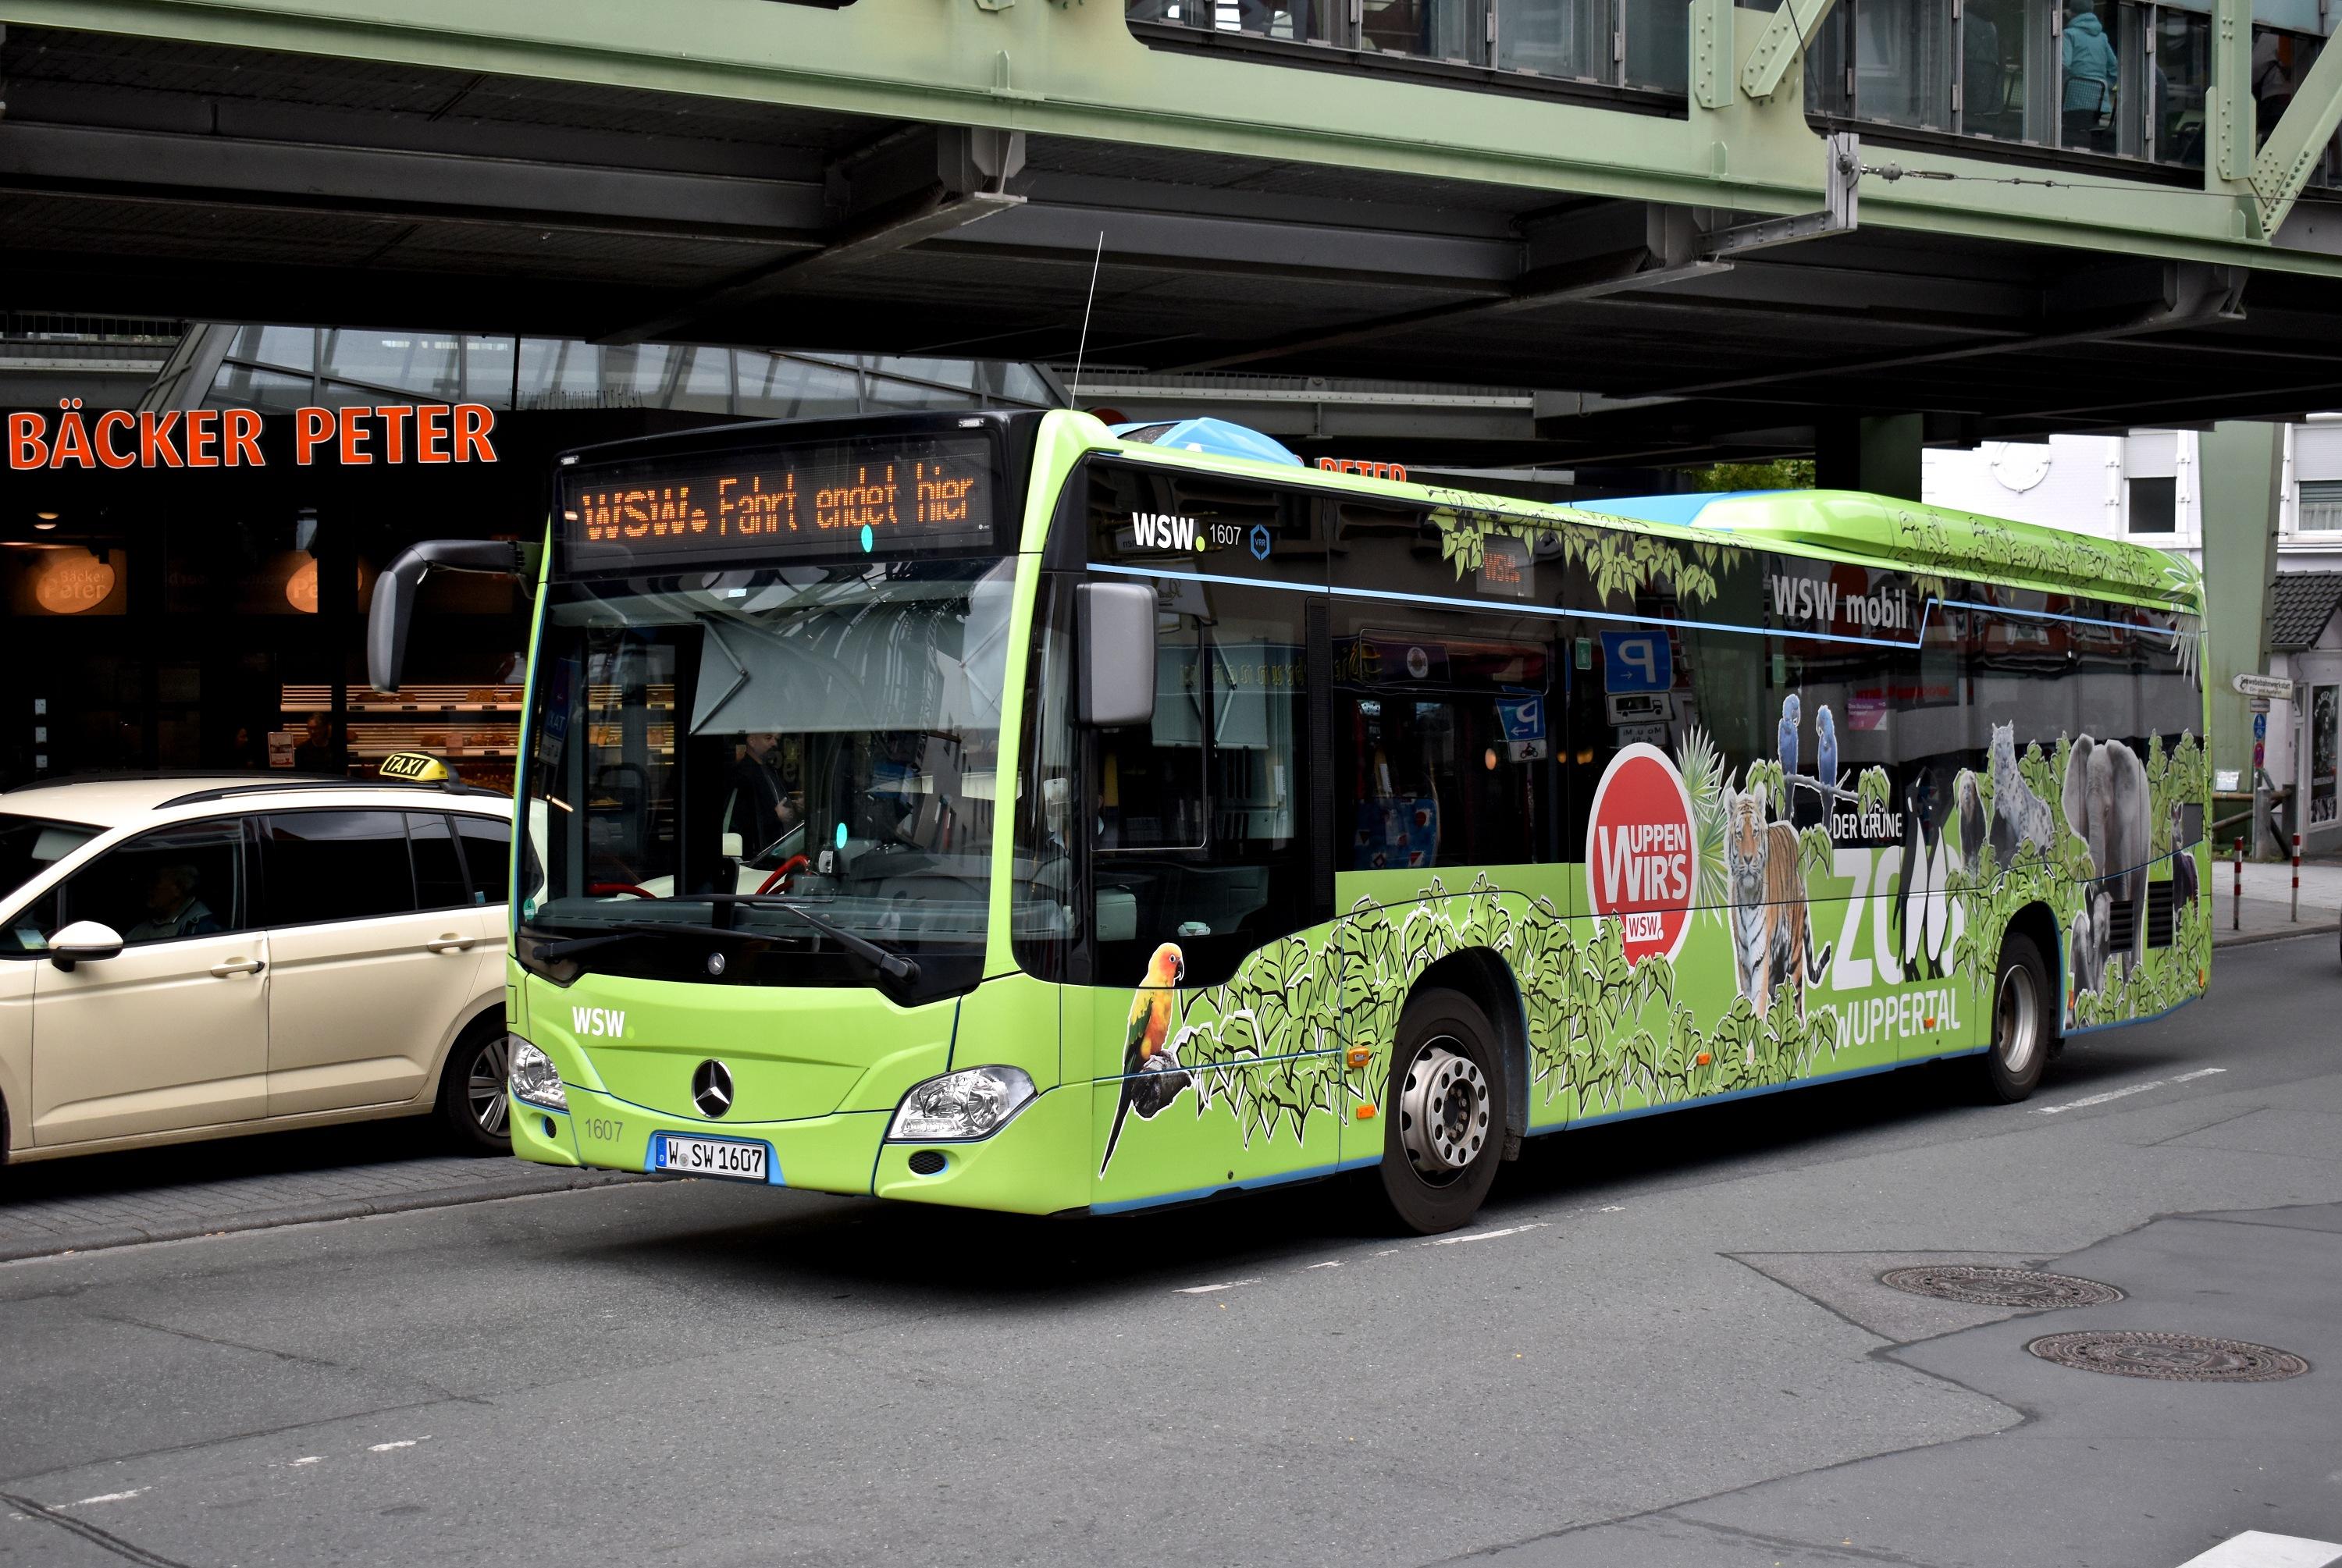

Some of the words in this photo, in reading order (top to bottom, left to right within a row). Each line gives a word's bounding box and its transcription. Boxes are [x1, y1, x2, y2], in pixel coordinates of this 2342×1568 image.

[9, 398, 266, 470] BÄCKER
[296, 404, 498, 466] PETER
[719, 473, 798, 535] Fahrt
[816, 464, 898, 528] endet
[917, 462, 973, 522] hier
[1210, 524, 1241, 546] 1607
[1255, 538, 1266, 547] VRR
[1772, 574, 1838, 622] WSW
[1846, 587, 1907, 630] mobil
[386, 756, 425, 775] TAXI
[1833, 813, 1858, 840] DER
[1861, 807, 1902, 839] GRÜNE
[1835, 987, 1961, 1050] WUPPERTAL
[586, 1118, 623, 1143] 1607
[669, 1141, 678, 1164] W
